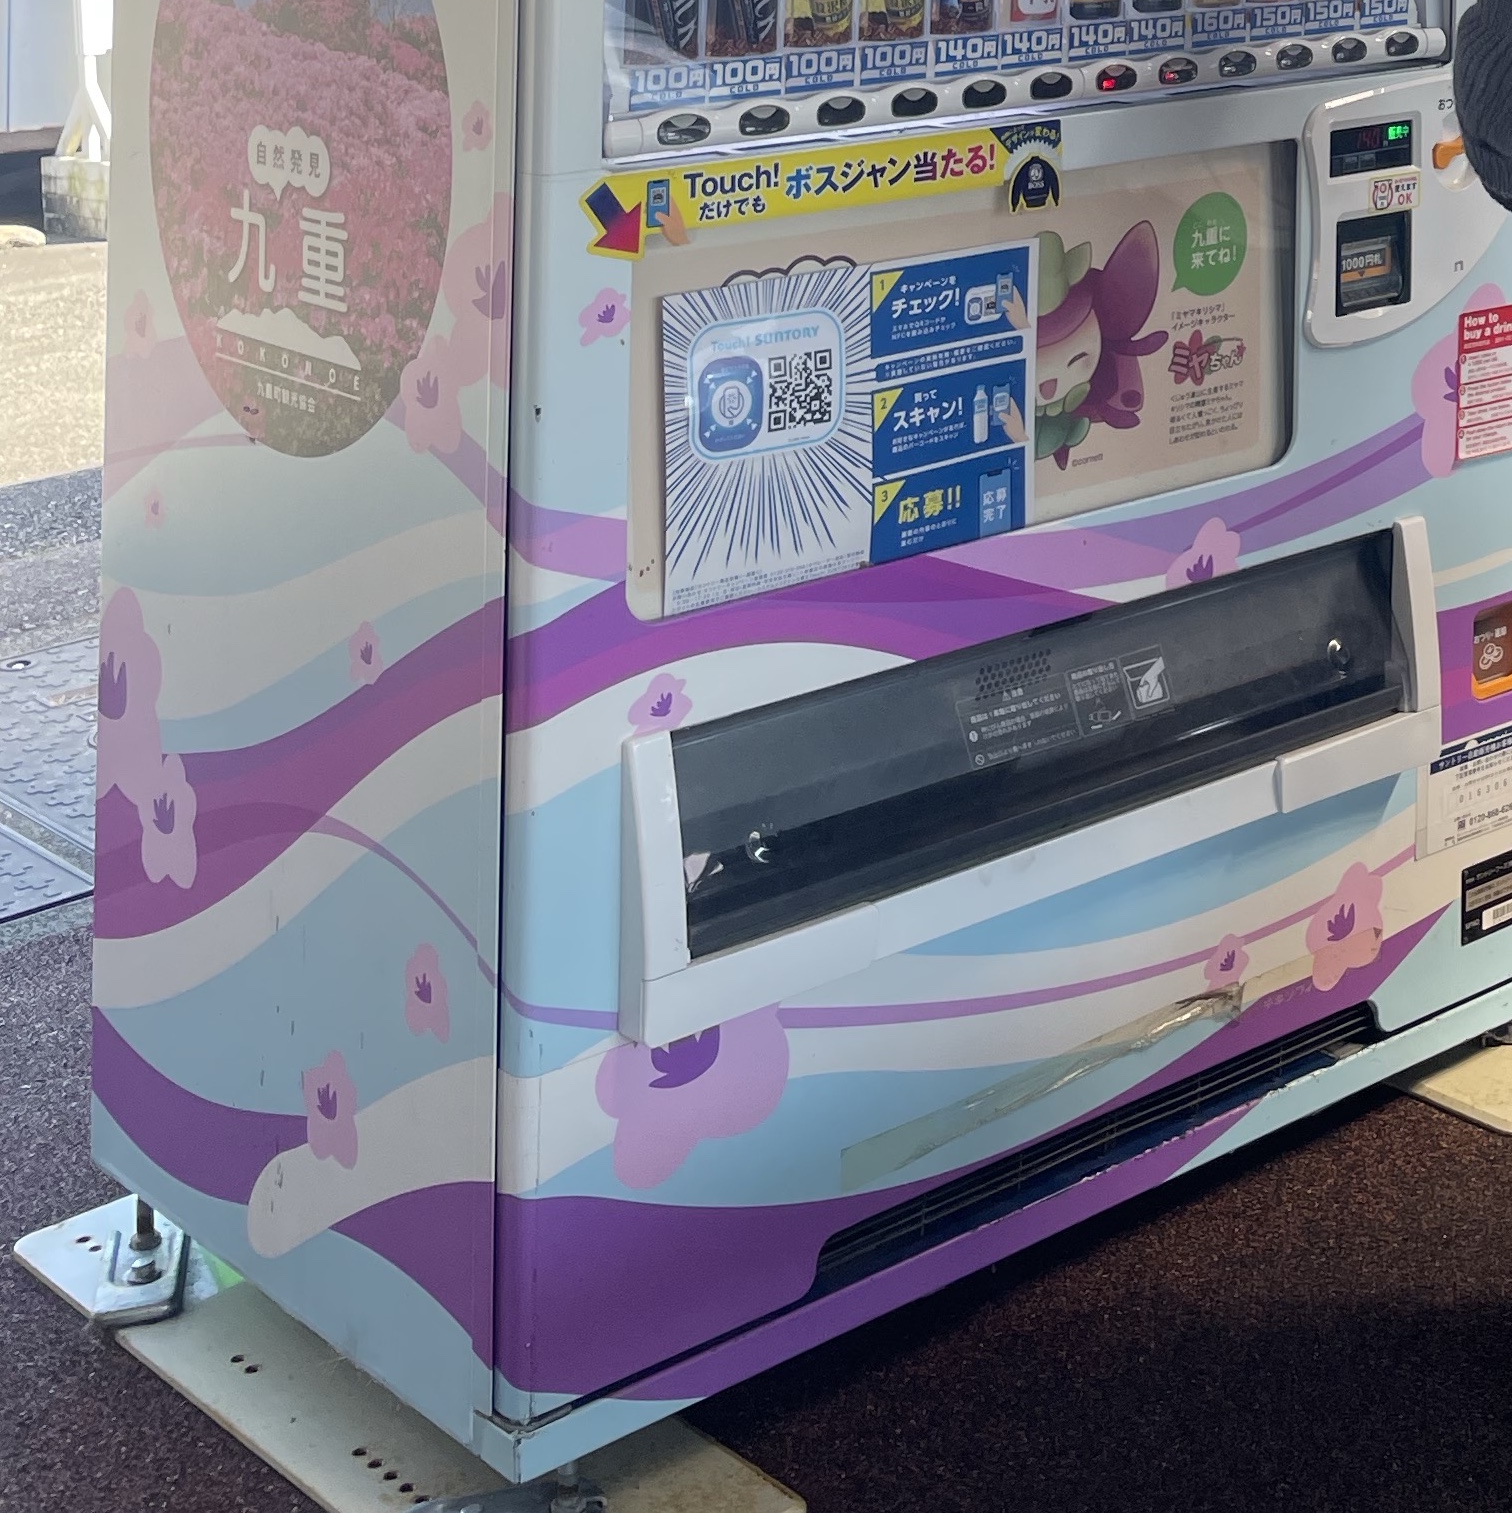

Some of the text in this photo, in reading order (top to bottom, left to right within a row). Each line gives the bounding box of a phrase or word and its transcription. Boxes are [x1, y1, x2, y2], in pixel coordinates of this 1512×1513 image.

[1193, 11, 1244, 31] 160円
[1253, 6, 1302, 27] 150円
[1307, 0, 1353, 21] 150円
[1071, 25, 1126, 46] 140円
[1130, 18, 1184, 39] 140円
[937, 38, 997, 61] 140円
[1004, 33, 1062, 55] 140円
[790, 53, 853, 77] 100円
[865, 45, 926, 68] 100円
[635, 66, 703, 92] 100円
[714, 60, 781, 85] 100円
[683, 161, 780, 200] Touch!
[784, 143, 997, 200] ボスジャン当たる!
[697, 194, 767, 222] だけでも
[1397, 192, 1413, 206] OK
[227, 188, 348, 313] 九重
[1341, 252, 1383, 272] 1000円札
[891, 287, 960, 319] チェック!
[1463, 312, 1499, 329] How to
[1463, 328, 1482, 342] buy
[1484, 326, 1491, 337] a
[893, 397, 963, 432] スキャン!
[898, 485, 961, 524] 応募!!
